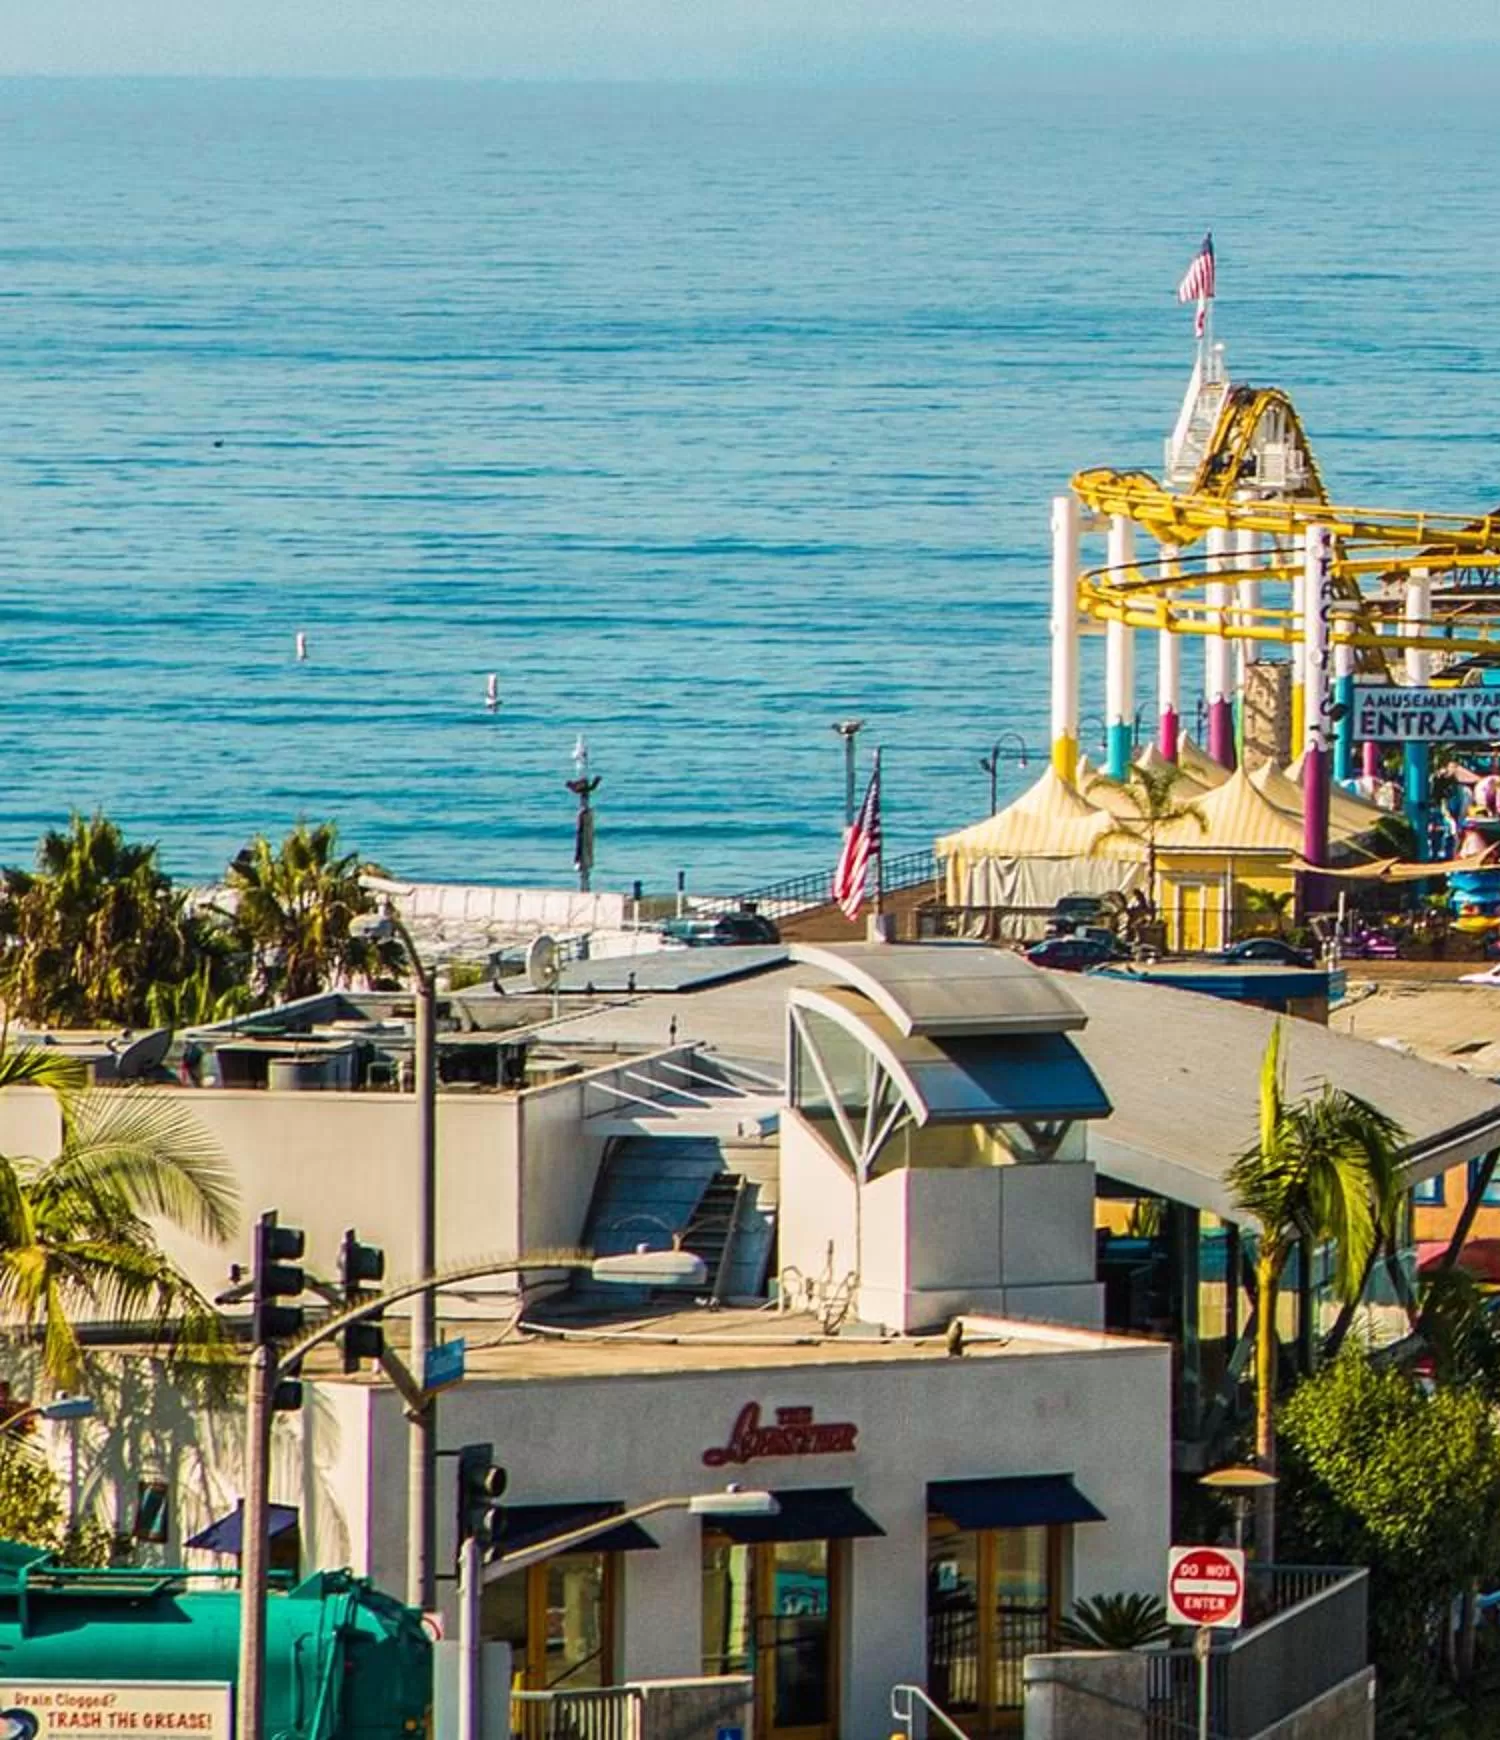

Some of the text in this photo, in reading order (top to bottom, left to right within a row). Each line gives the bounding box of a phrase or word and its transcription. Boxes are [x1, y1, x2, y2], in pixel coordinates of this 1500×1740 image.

[1363, 692, 1466, 707] AMUSEMENT
[1180, 1563, 1231, 1577] DO NOT
[1183, 1596, 1226, 1610] ENTER
[13, 1692, 117, 1709] Drain Clogged?
[47, 1712, 213, 1730] TRASH THE GREASE!
